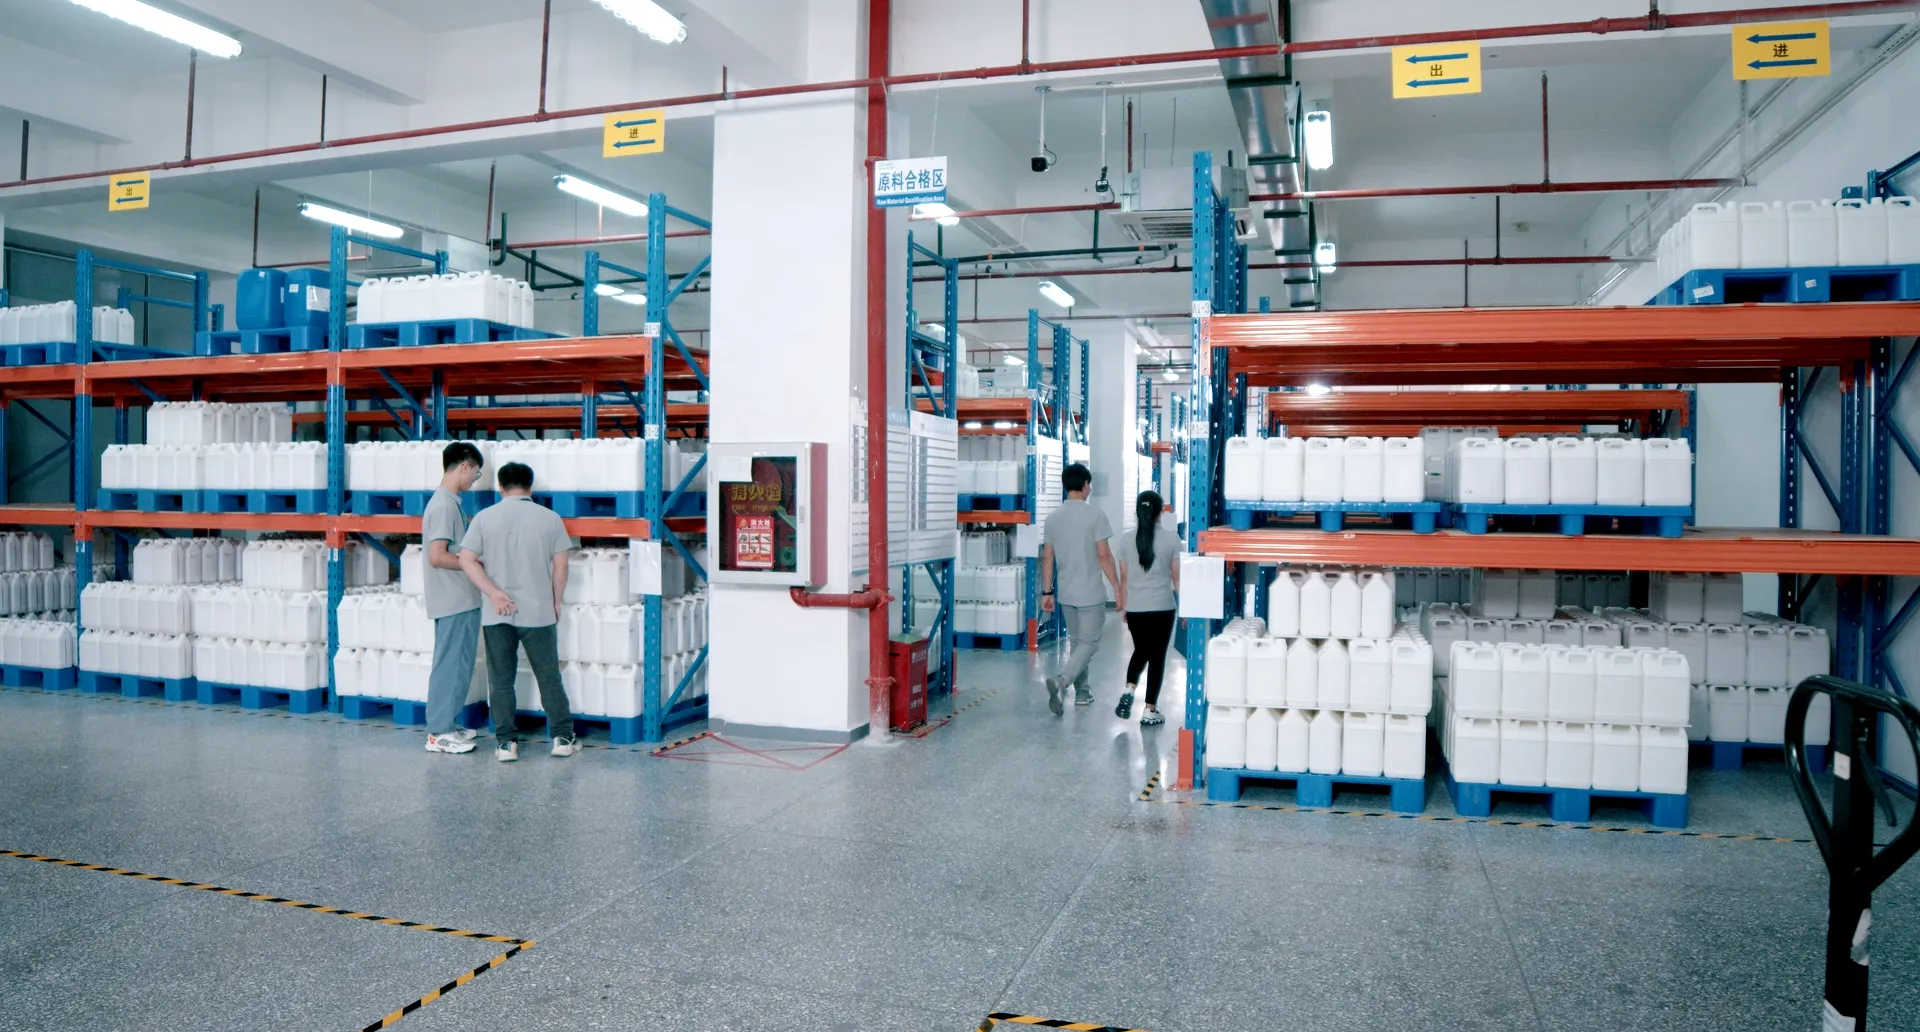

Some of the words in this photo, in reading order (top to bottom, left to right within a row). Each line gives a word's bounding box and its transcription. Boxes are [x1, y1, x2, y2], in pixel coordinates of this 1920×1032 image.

[1773, 43, 1789, 58] 进
[1430, 63, 1443, 76] 出
[628, 127, 639, 139] 进
[877, 168, 944, 191] 原料合格区
[125, 186, 133, 196] 出
[1193, 302, 1210, 314] A1-3
